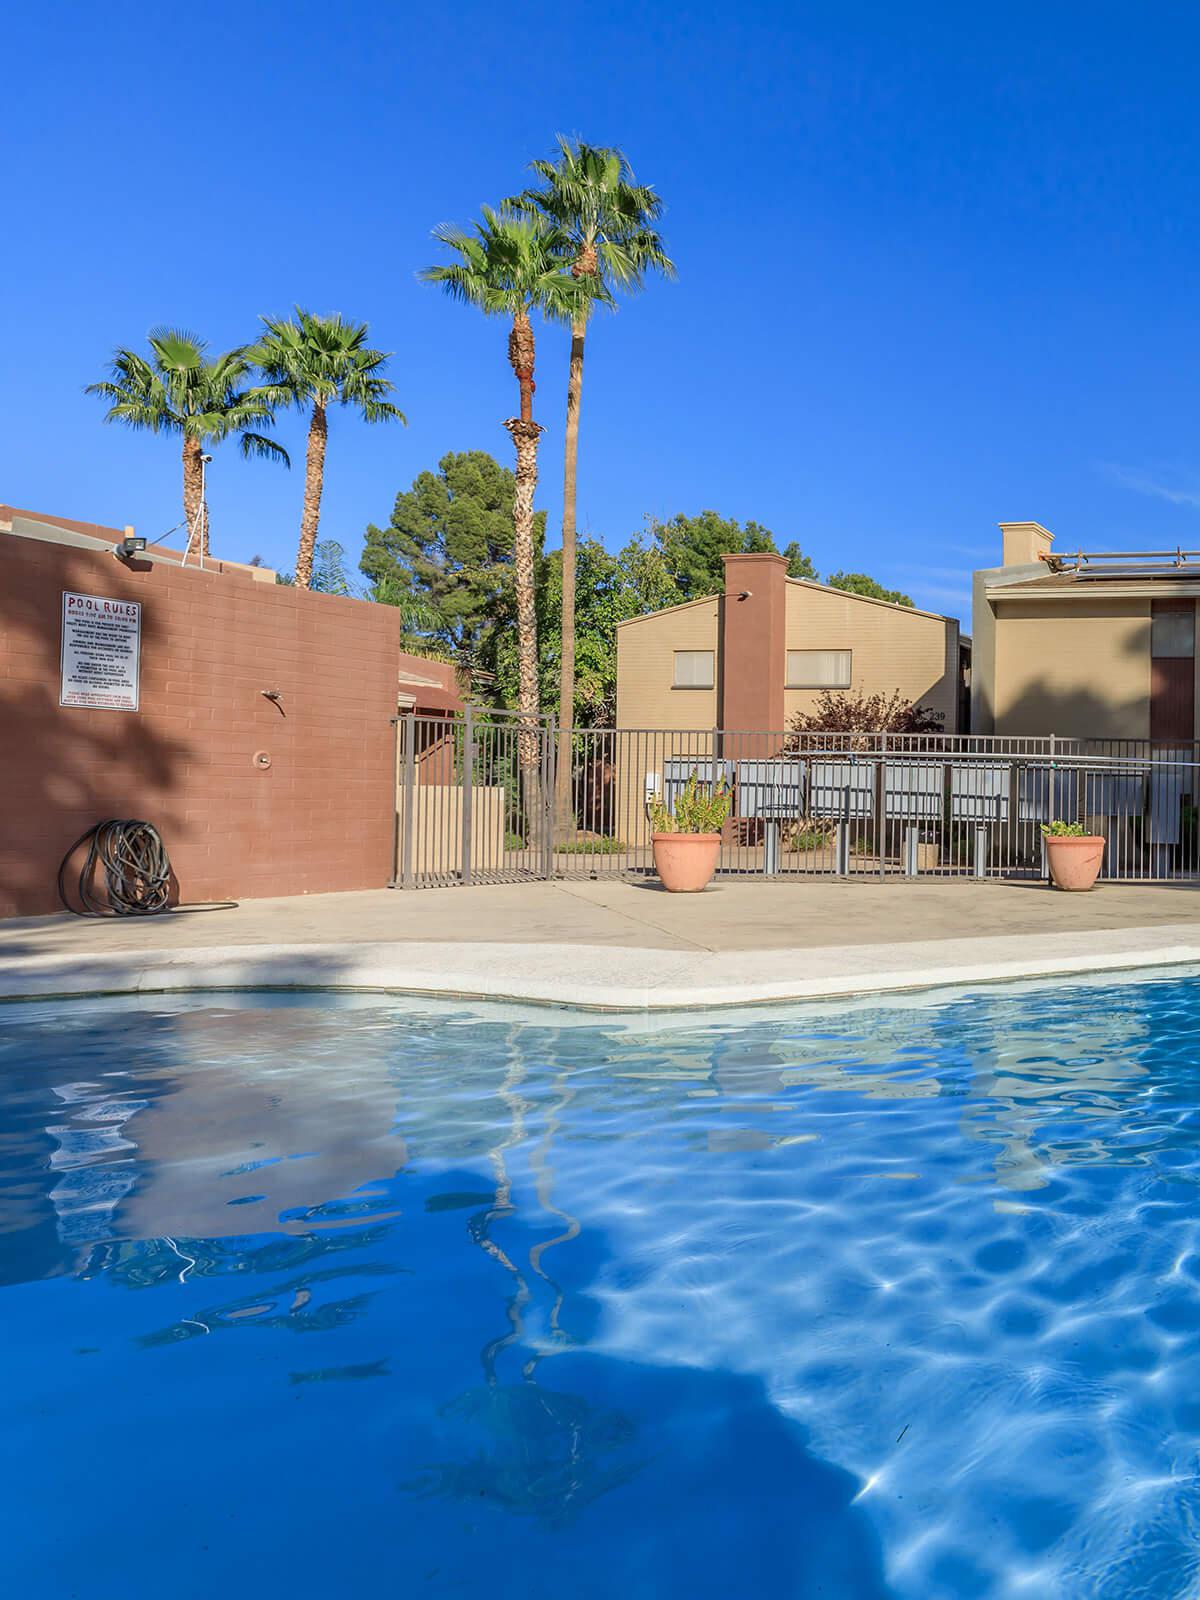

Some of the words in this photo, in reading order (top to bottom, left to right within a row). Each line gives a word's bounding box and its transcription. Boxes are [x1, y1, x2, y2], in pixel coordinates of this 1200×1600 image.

[68, 597, 99, 611] POOL
[104, 602, 136, 616] RULES
[929, 712, 945, 721] 239
